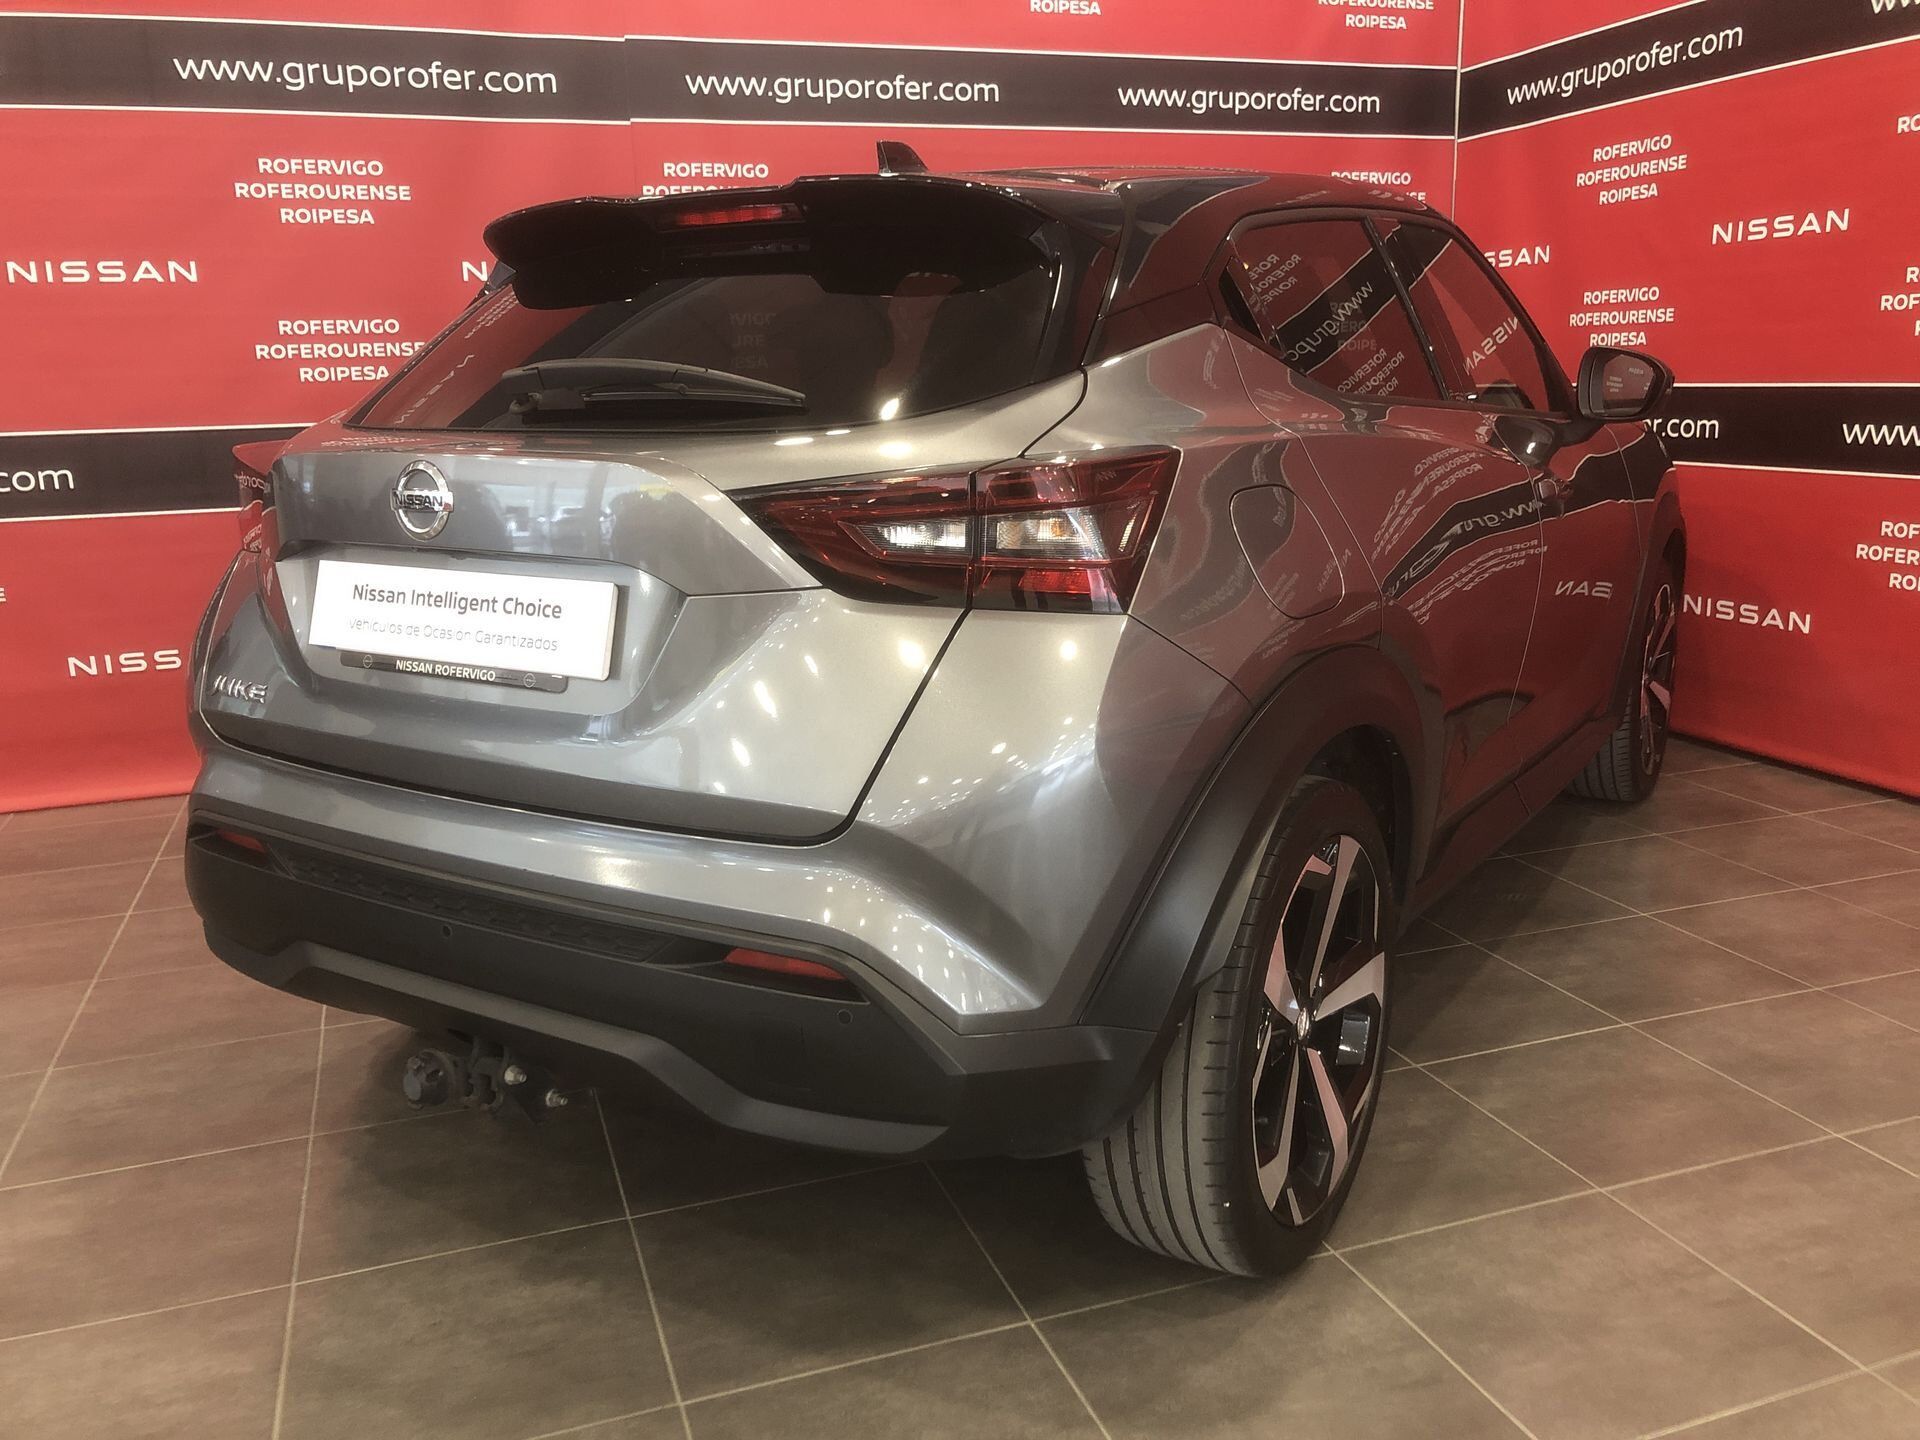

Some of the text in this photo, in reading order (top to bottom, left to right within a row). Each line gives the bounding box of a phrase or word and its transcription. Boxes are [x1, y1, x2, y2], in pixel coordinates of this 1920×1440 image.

[1030, 0, 1101, 15] ROIPESA
[1345, 14, 1407, 29] ROIPESA
[172, 58, 557, 93] www.gruporofer.com
[1507, 26, 1743, 105] www.gruporofer.com
[685, 72, 999, 105] www.gruporofer.com
[1117, 87, 1380, 115] www.gruporofer.com
[1593, 134, 1672, 162] ROFERVIGO
[257, 158, 384, 177] ROFERVIGO
[663, 162, 769, 179] ROFERVIGO
[1576, 154, 1688, 187] ROFEROURENSE
[234, 182, 412, 201] ROFEROURENSE
[1599, 182, 1658, 205] ROIPESA
[279, 207, 375, 225] ROIPESA
[1711, 208, 1850, 245] NISSAN
[6, 260, 198, 283] NISSAN
[1583, 286, 1660, 305] ROFERVIGO
[278, 319, 400, 336] ROFERVIGO
[1569, 307, 1675, 327] ROFEROURENSE
[1590, 331, 1647, 347] ROIPESA
[299, 365, 390, 383] ROIPESA
[394, 494, 443, 507] NISSAN
[352, 583, 563, 619] Nissan Intelligent Choice
[1683, 594, 1811, 634] NISSAN
[405, 624, 420, 637] de
[474, 630, 559, 651] Garantizados
[395, 659, 497, 682] NISSAN ROFERVIGO
[210, 675, 267, 703] JUKE
